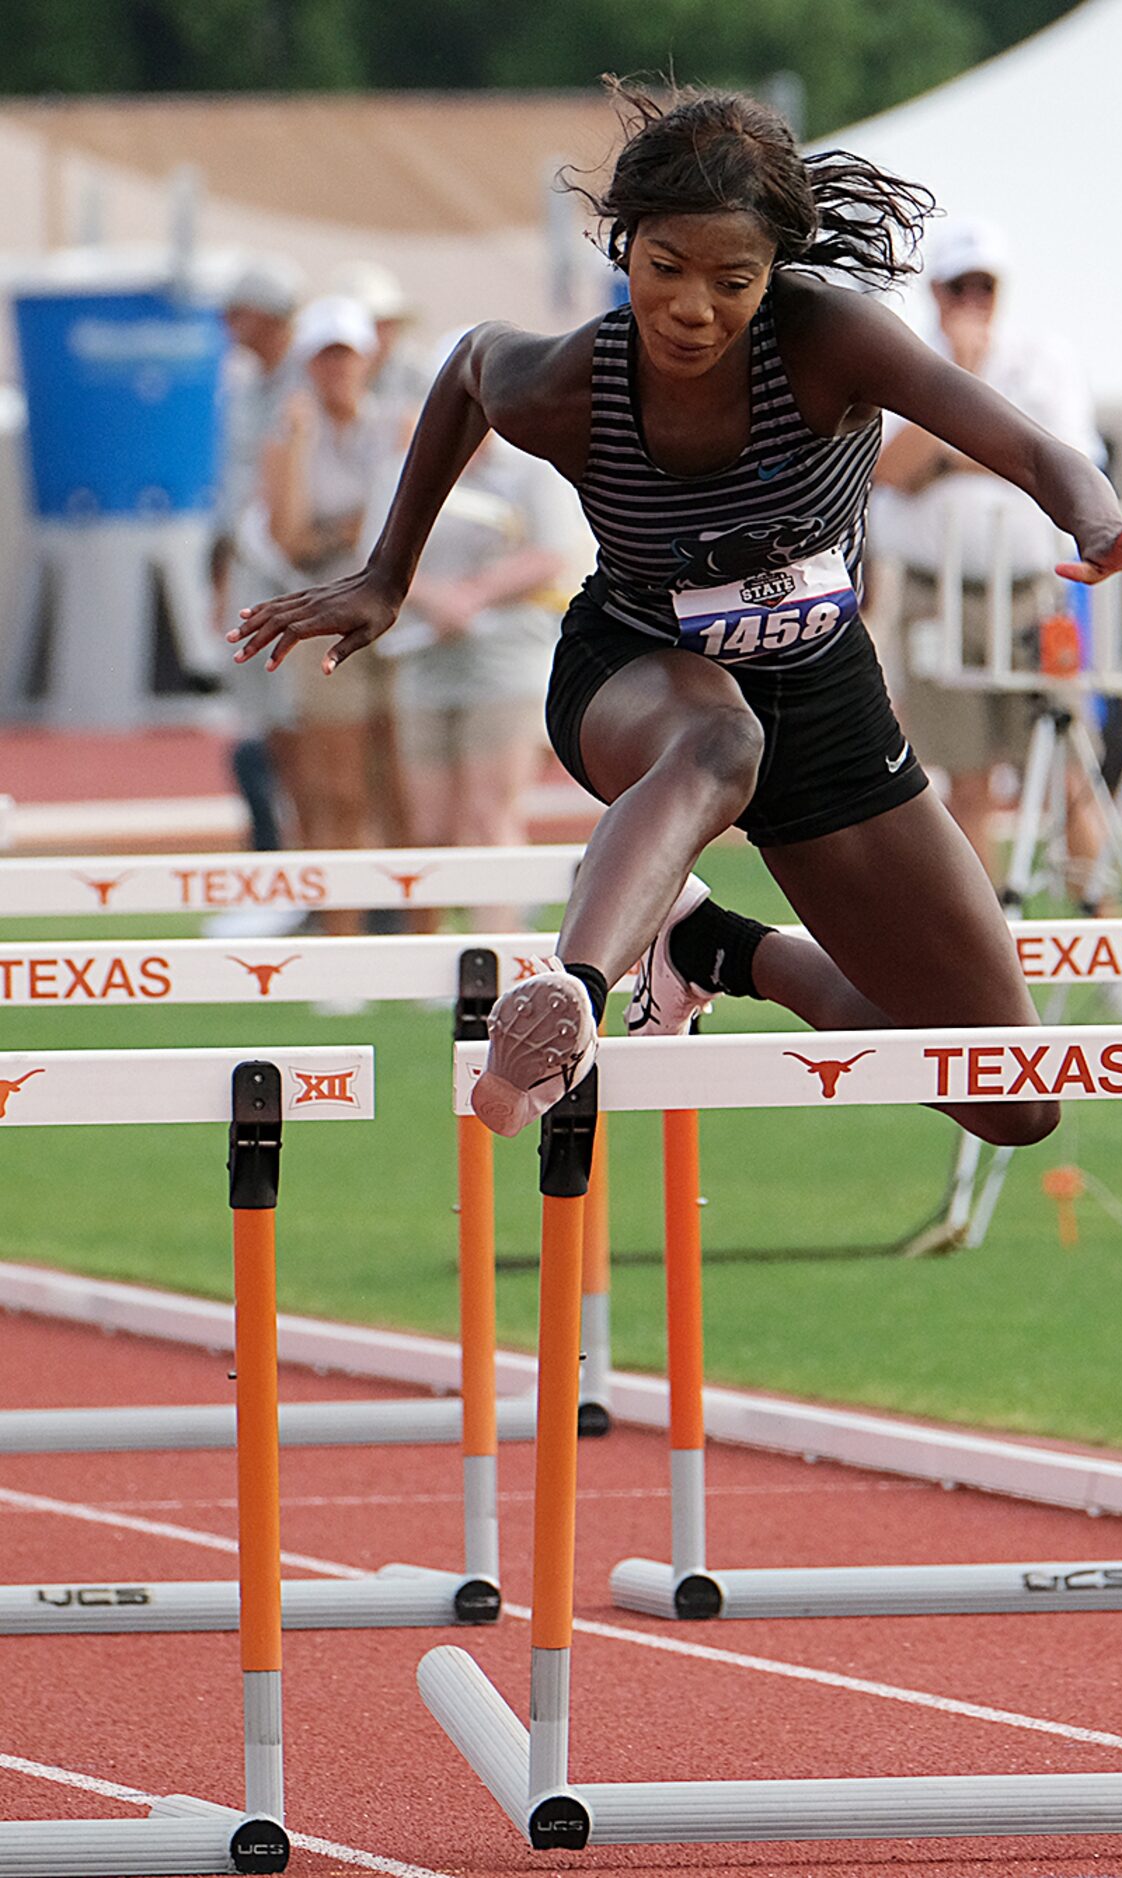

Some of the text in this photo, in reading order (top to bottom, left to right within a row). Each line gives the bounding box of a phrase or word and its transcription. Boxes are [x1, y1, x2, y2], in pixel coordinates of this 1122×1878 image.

[741, 577, 794, 601] STATE
[699, 602, 841, 655] 1458
[172, 866, 329, 906] TEXAS
[0, 956, 172, 1000] TEXAS
[294, 1071, 355, 1104] XII
[536, 1819, 584, 1832] UCS
[237, 1843, 285, 1856] UCS
